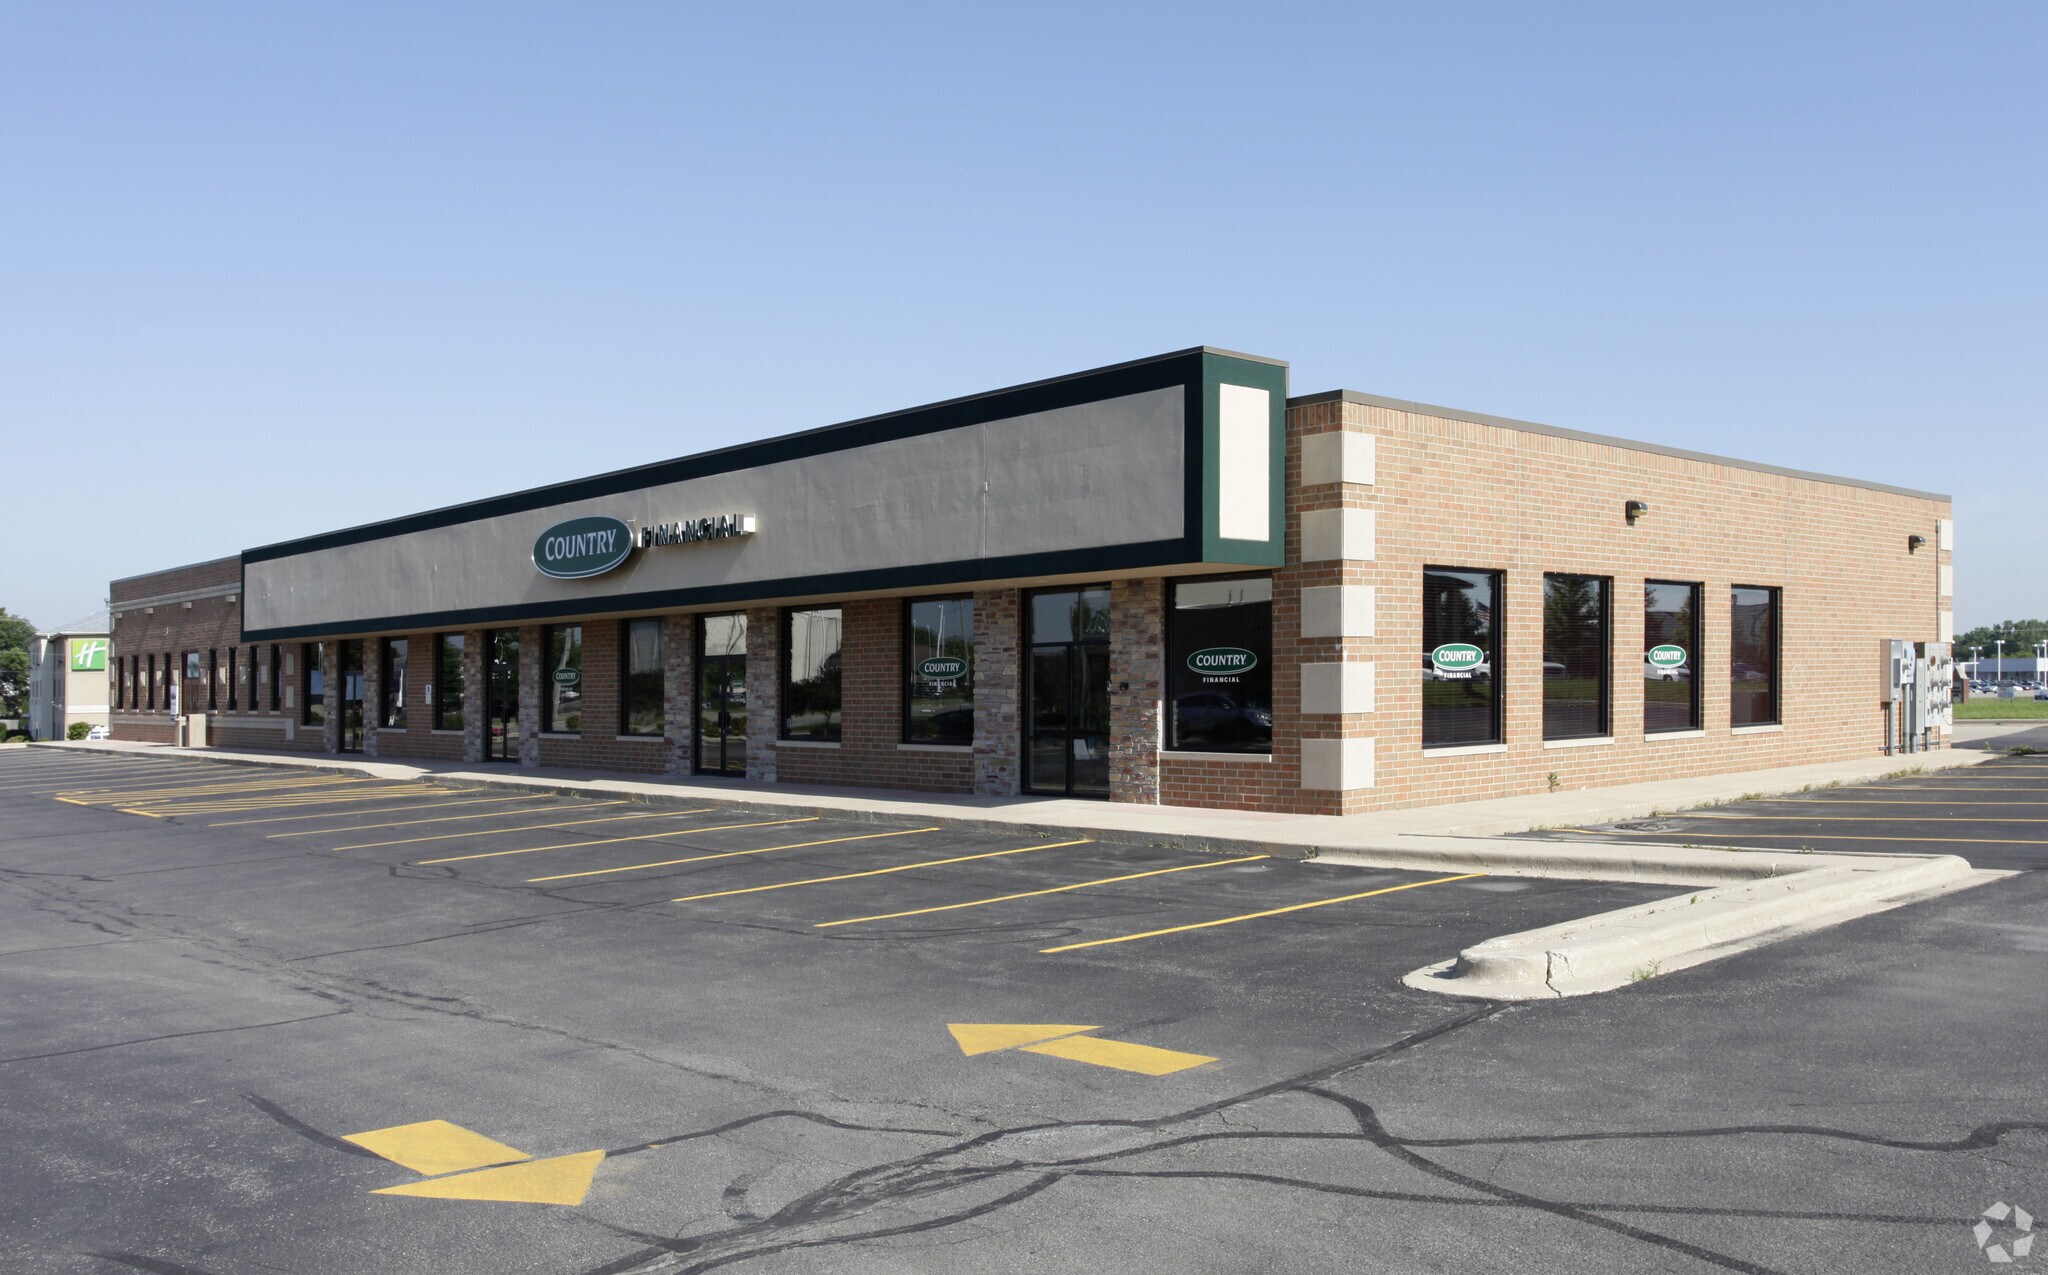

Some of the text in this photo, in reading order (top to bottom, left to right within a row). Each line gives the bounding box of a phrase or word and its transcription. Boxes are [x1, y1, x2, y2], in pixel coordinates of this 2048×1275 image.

[545, 513, 747, 561] COUNTRY FINANCIAL
[1196, 654, 1247, 666] COUNTRY
[1439, 650, 1477, 662] COUNTRY
[1653, 650, 1682, 661] COUNTRY
[924, 662, 961, 673] COUNTRY
[555, 672, 577, 680] COUNTRY
[1443, 671, 1472, 679] FINANCIAL
